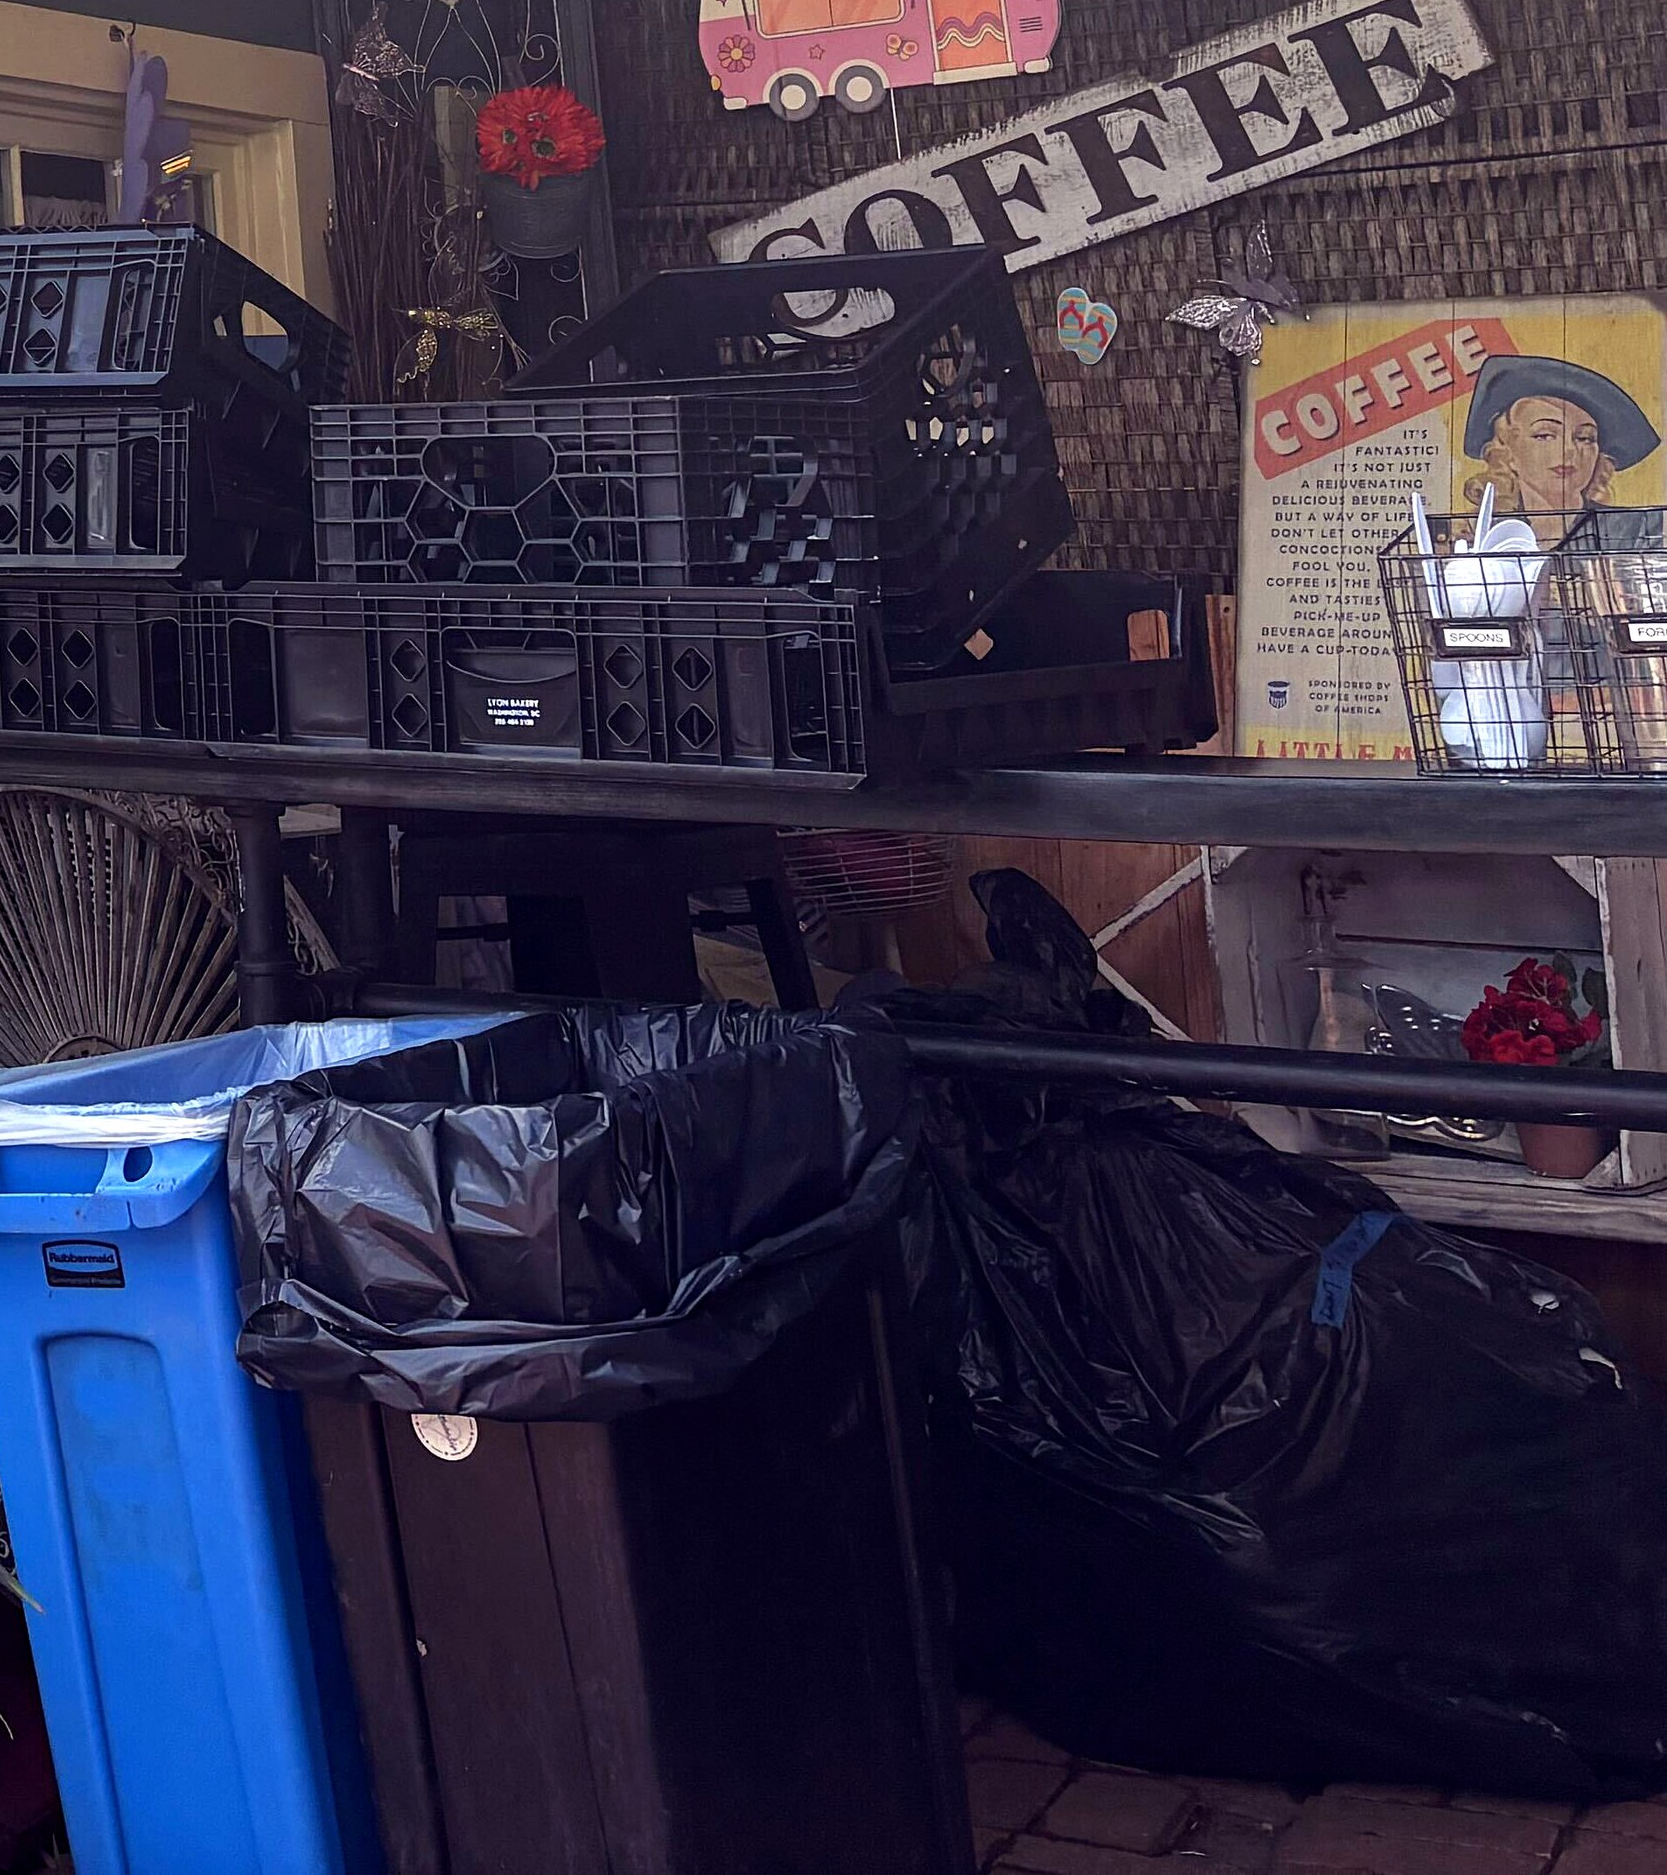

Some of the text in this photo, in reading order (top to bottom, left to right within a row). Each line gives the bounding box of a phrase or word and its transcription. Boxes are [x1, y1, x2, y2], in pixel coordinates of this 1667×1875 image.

[1260, 324, 1491, 457] COFFEE
[1403, 428, 1428, 439] IT'S
[1355, 446, 1439, 456] FANTASTIC!
[1334, 462, 1431, 473] IT'S NOT JUST
[1301, 479, 1423, 489] A REJUVENATING
[1272, 495, 1346, 506] DELICIOUS
[1275, 512, 1301, 522] BUT
[1307, 512, 1316, 522] A
[1323, 512, 1355, 522] WAY
[1360, 512, 1379, 522] OF
[1271, 528, 1399, 539] DON'T LET OTHER
[1292, 561, 1371, 572] FOOL YOU.
[1266, 577, 1320, 588] COFFEE
[1325, 577, 1338, 588] IS
[1343, 578, 1371, 589] THE
[1289, 594, 1382, 605] AND TASTIES
[1293, 608, 1381, 622] PICK-ME-UP
[1261, 626, 1395, 639] BEVERAGE AROUN
[1449, 632, 1504, 643] SPOONS
[1638, 627, 1667, 638] FOR
[1257, 643, 1295, 654] HAVE
[1301, 644, 1310, 654] A
[1376, 681, 1392, 690] BY
[1354, 693, 1389, 702] SHOPS
[1315, 704, 1328, 713] OF
[48, 1252, 116, 1264] Rubbermaid
